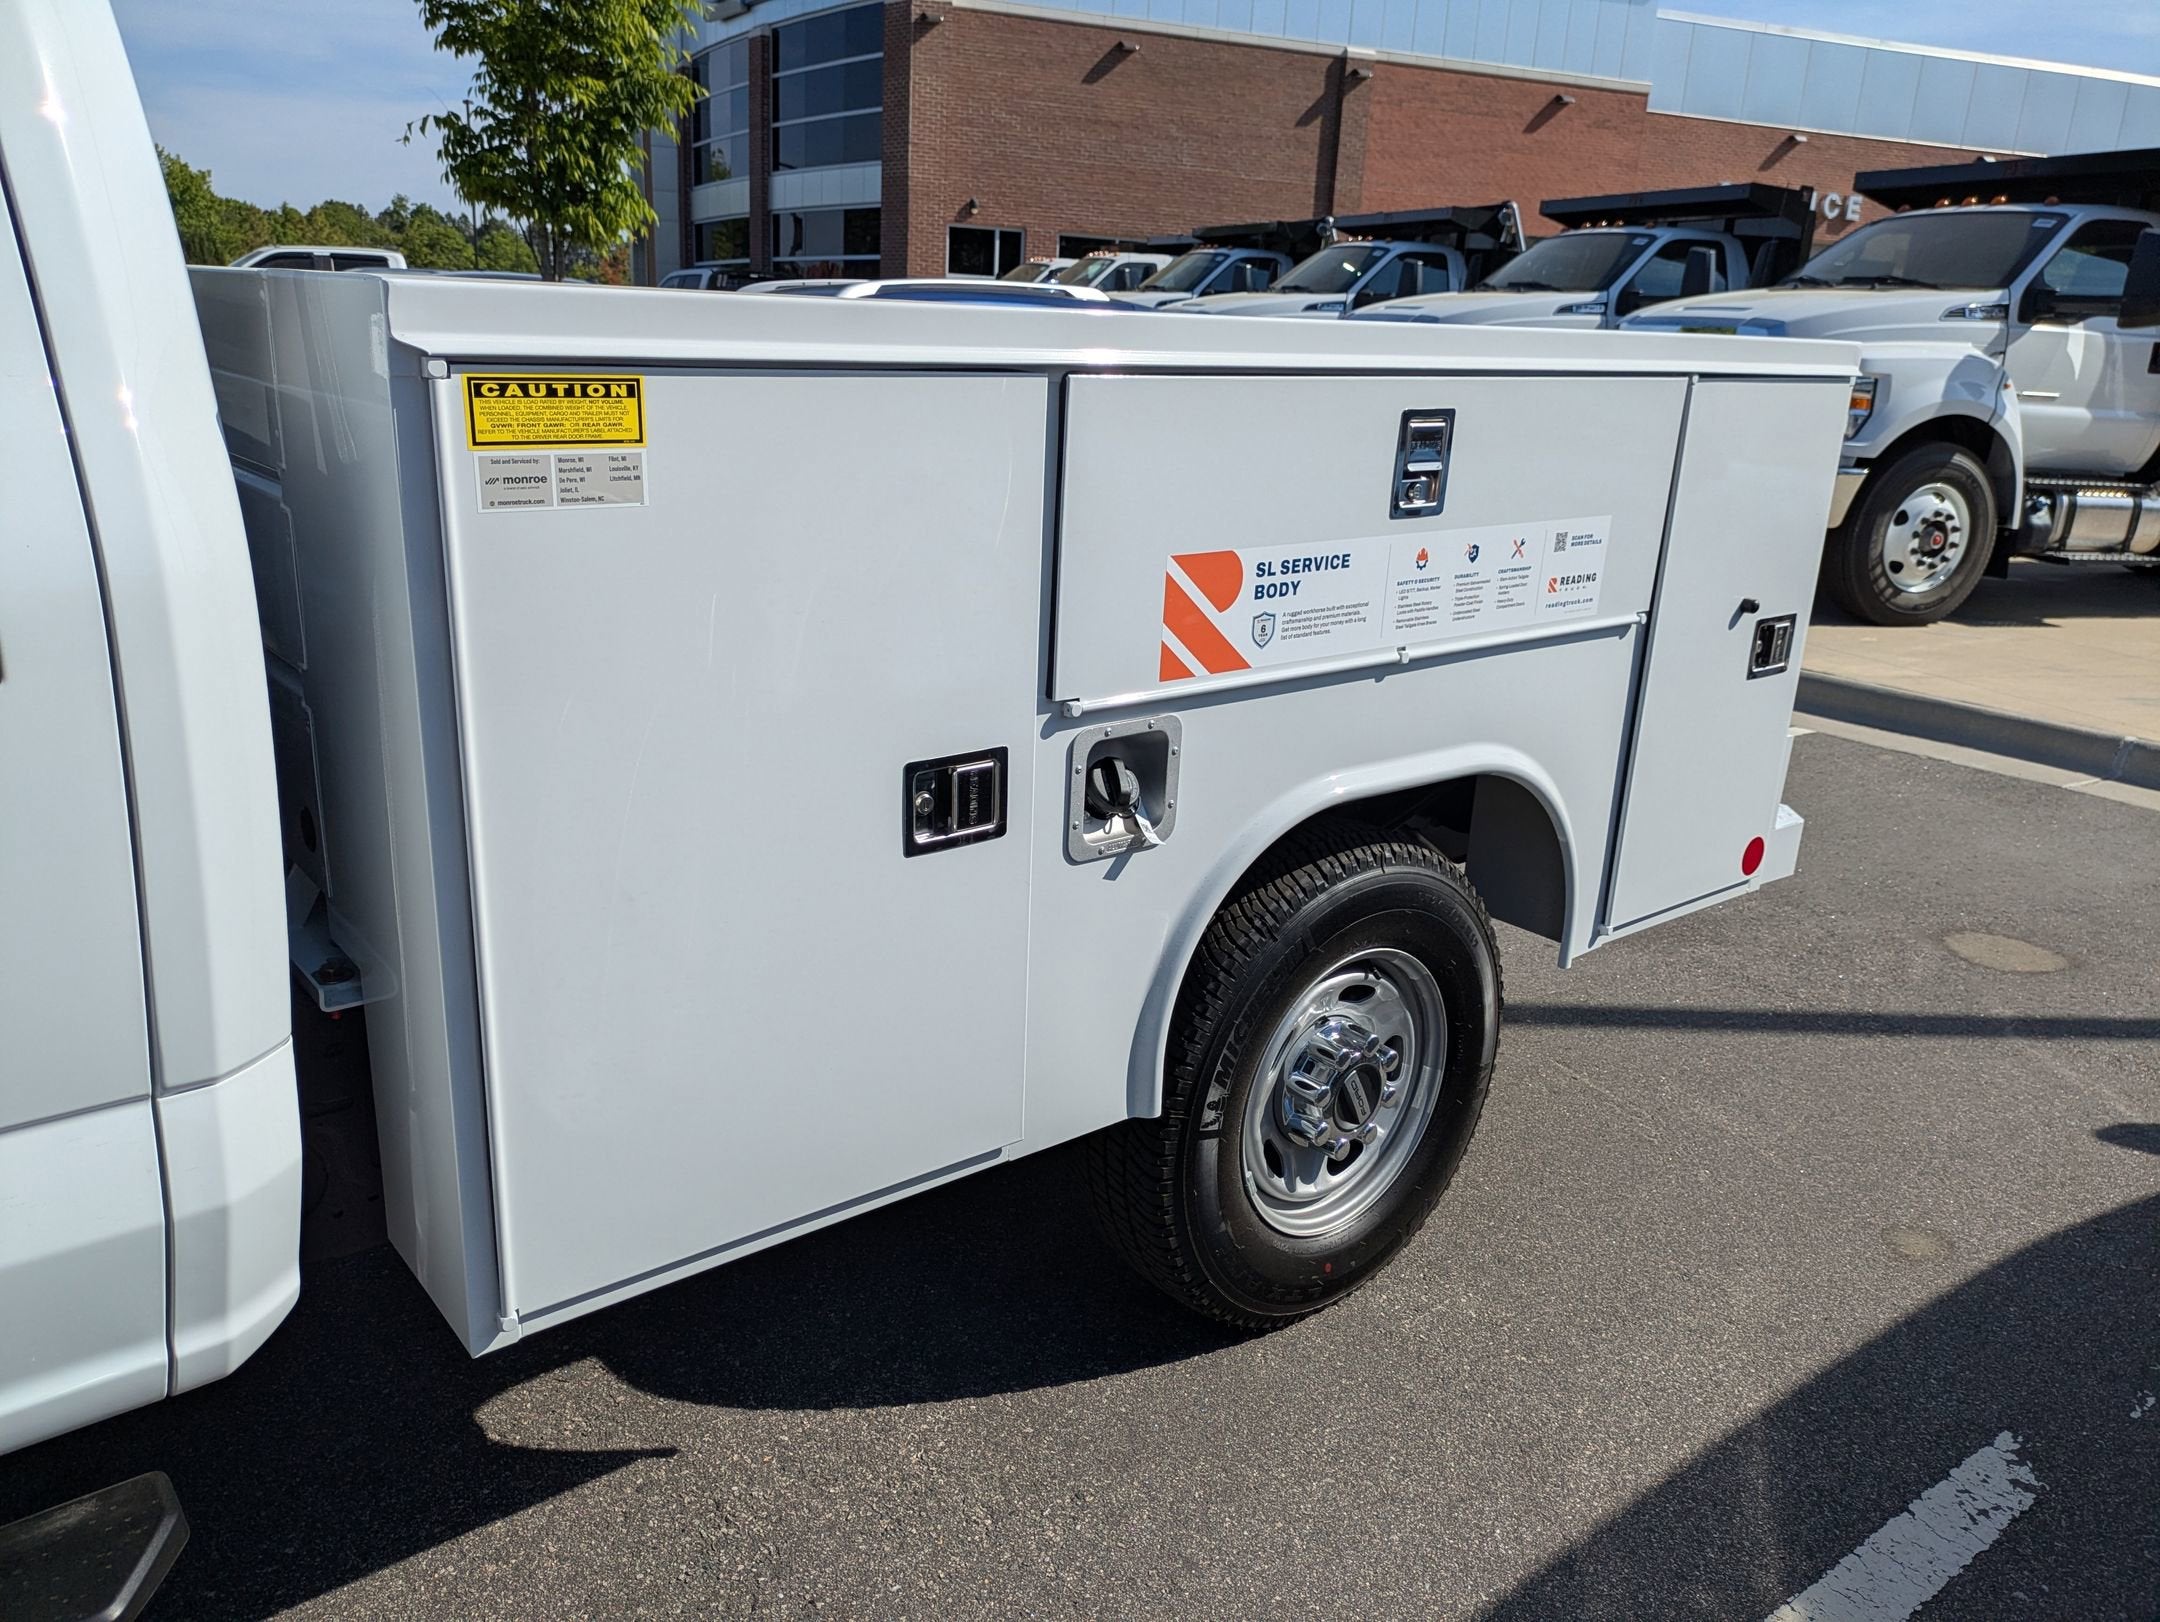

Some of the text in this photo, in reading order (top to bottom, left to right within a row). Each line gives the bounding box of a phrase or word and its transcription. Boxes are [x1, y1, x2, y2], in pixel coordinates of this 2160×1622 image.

[480, 384, 627, 397] CAUTION
[503, 476, 548, 484] monroe
[1256, 554, 1351, 578] SL SERVICE
[1498, 566, 1531, 574] CRAFTSMANSHIP
[1560, 573, 1597, 586] READING
[1254, 580, 1301, 600] BODY
[1545, 598, 1593, 608] readingtruck.com
[1287, 610, 1302, 618] rugged
[1345, 601, 1369, 611] exceptional
[1282, 616, 1313, 625] craftsmanship
[1261, 624, 1266, 633] 6
[1293, 630, 1312, 639] standard
[1351, 1080, 1366, 1116] FORD
